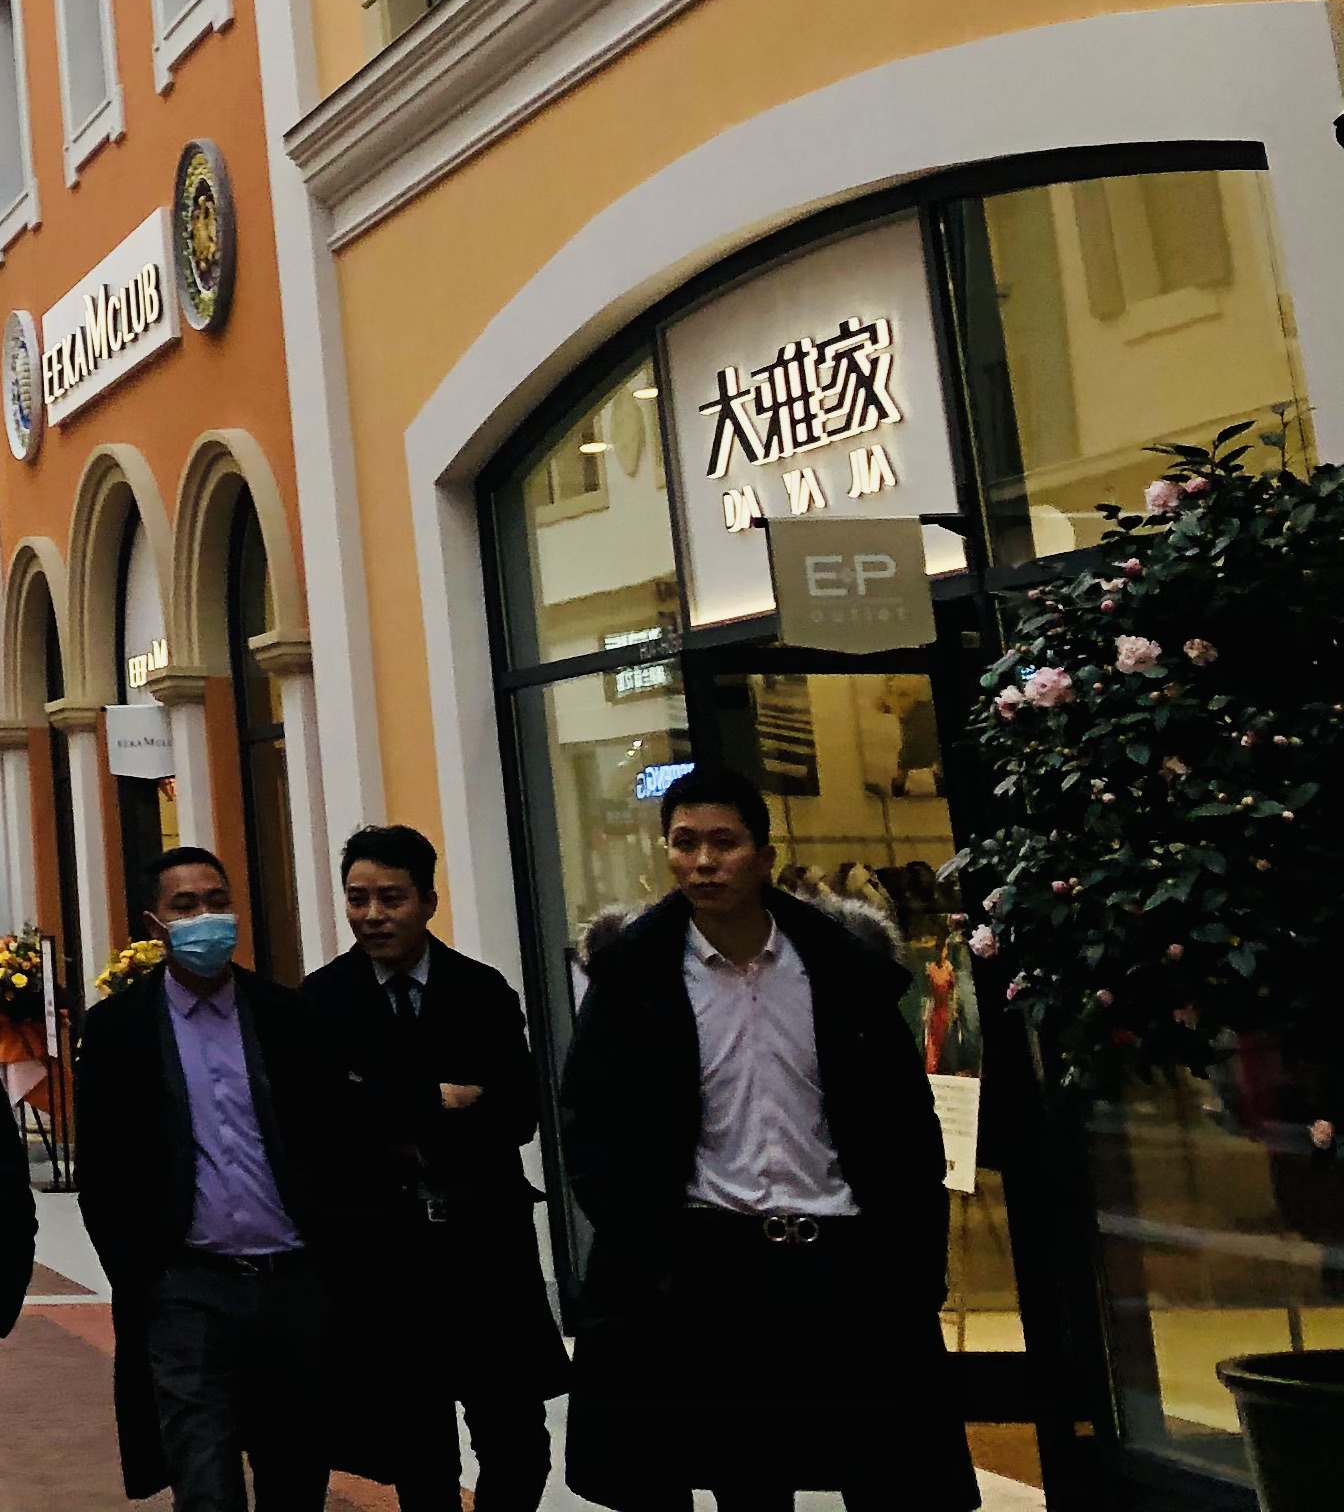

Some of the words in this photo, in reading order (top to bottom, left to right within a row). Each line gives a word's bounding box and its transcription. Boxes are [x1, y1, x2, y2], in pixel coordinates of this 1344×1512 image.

[698, 316, 902, 479] 大雅家
[805, 554, 896, 597] EP
